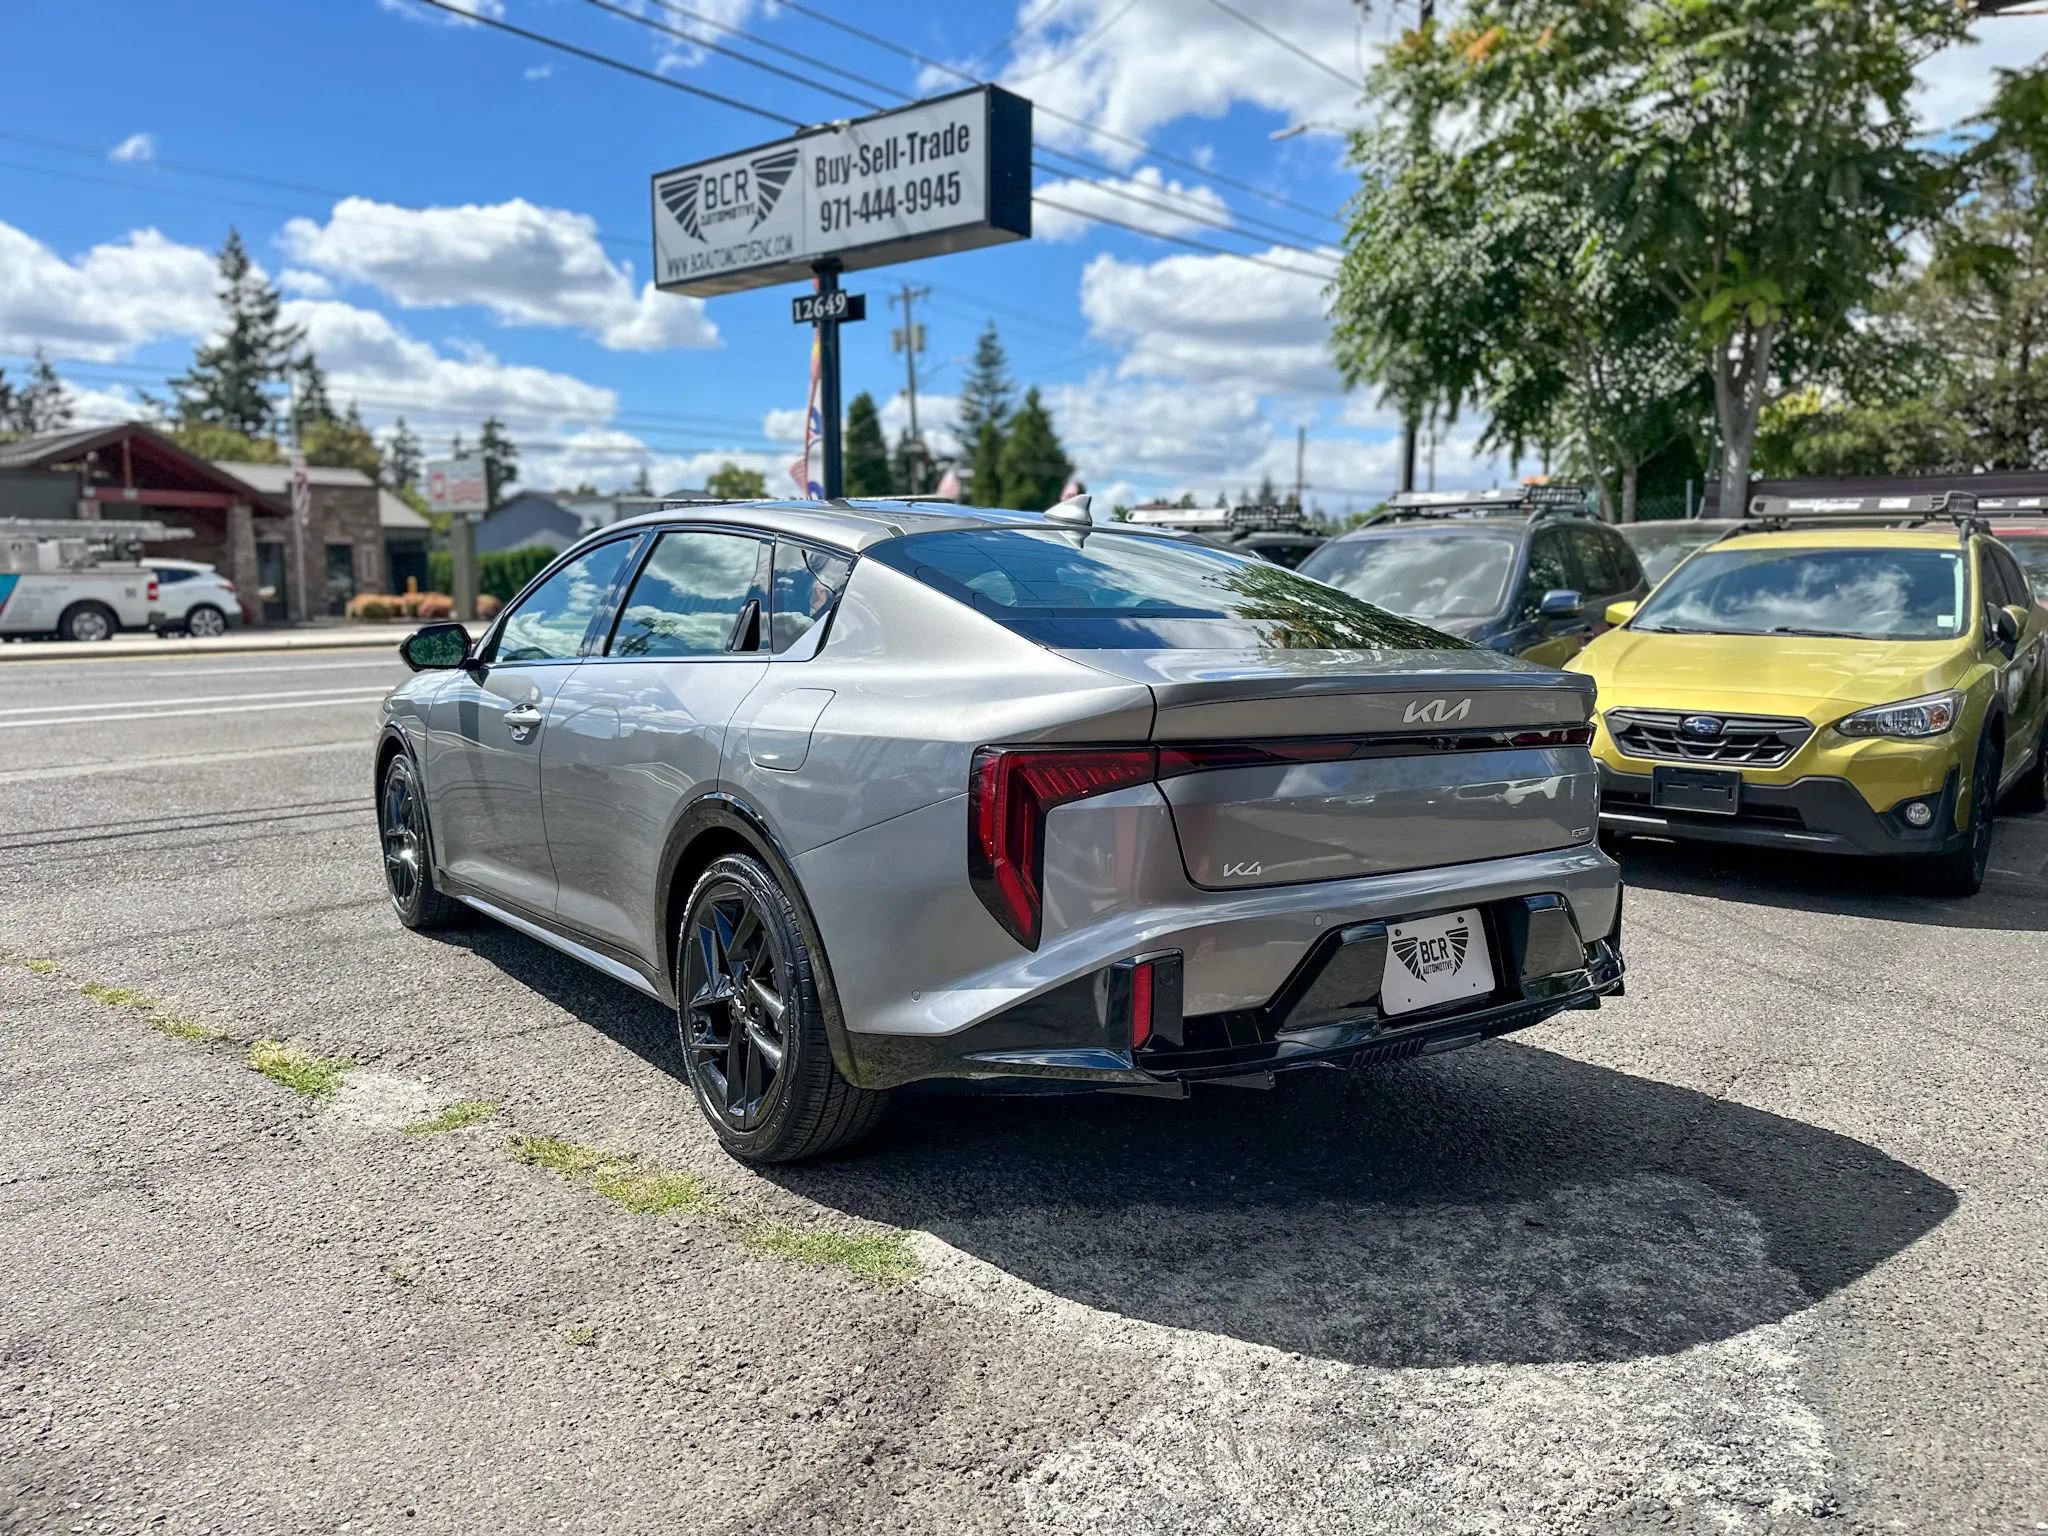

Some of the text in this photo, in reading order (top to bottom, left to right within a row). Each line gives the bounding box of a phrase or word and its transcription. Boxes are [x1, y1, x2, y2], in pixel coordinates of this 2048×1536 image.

[815, 121, 970, 188] Buy-Sell-Trade
[704, 168, 748, 211] BCR
[820, 170, 961, 233] 971-444-9945
[794, 293, 847, 320] 12649
[1402, 698, 1472, 723] KIA
[1223, 861, 1262, 877] K4
[1419, 937, 1449, 964] BCR
[1422, 959, 1454, 975] AUTOMOTIVE
